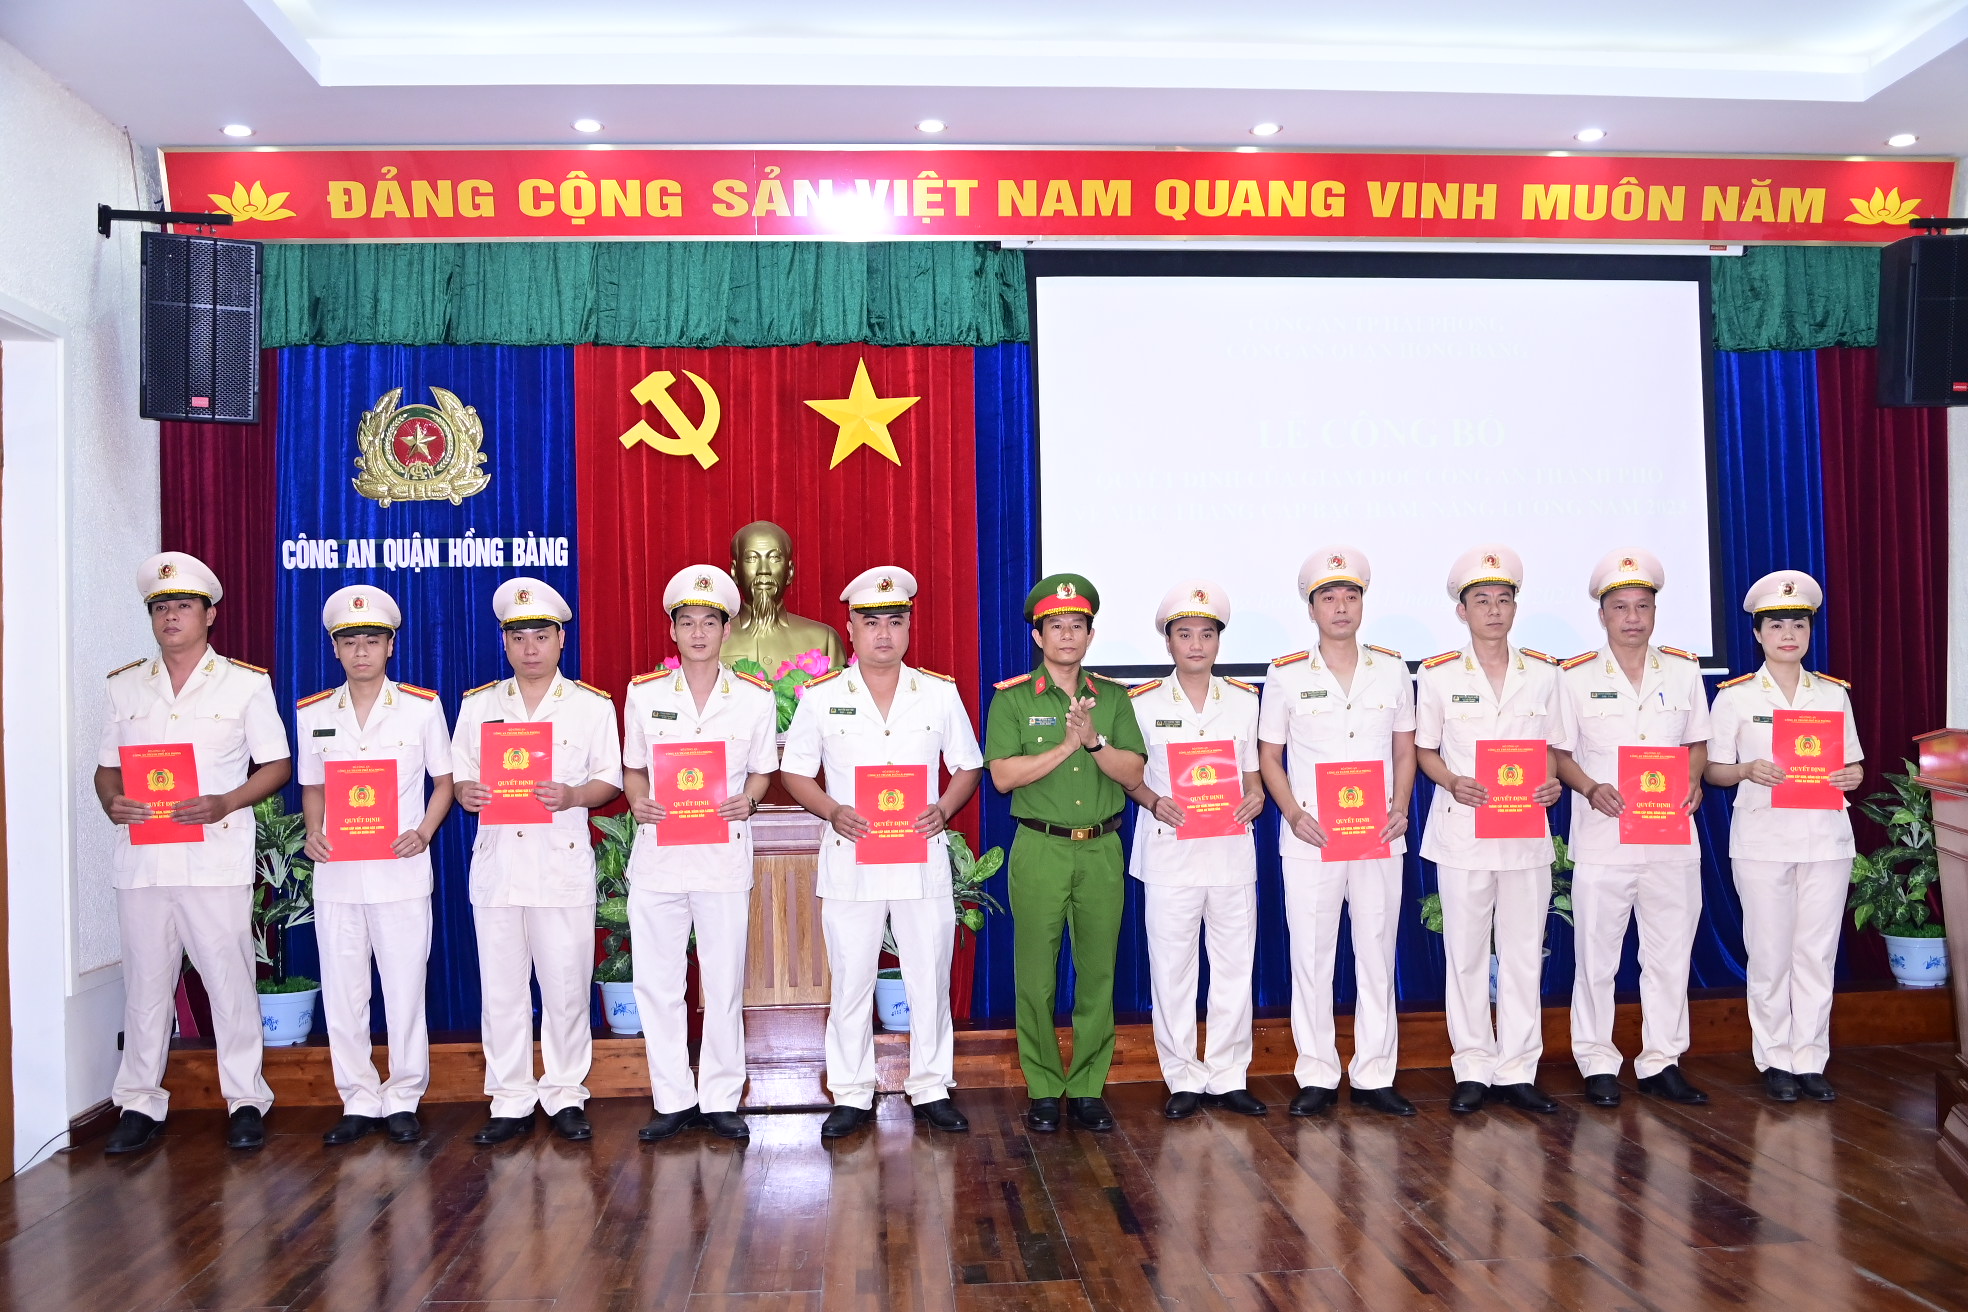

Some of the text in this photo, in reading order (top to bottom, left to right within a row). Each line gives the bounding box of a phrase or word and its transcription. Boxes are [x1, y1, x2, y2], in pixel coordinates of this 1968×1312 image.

[327, 166, 1825, 224] ĐẢNG CỘNG SẢN VIỆT NAM QUANG VINH MUÔN NĂM
[1320, 410, 1441, 449] CÔNG
[282, 528, 568, 572] CÔNG AN QUẬN HỒNG BÀNG
